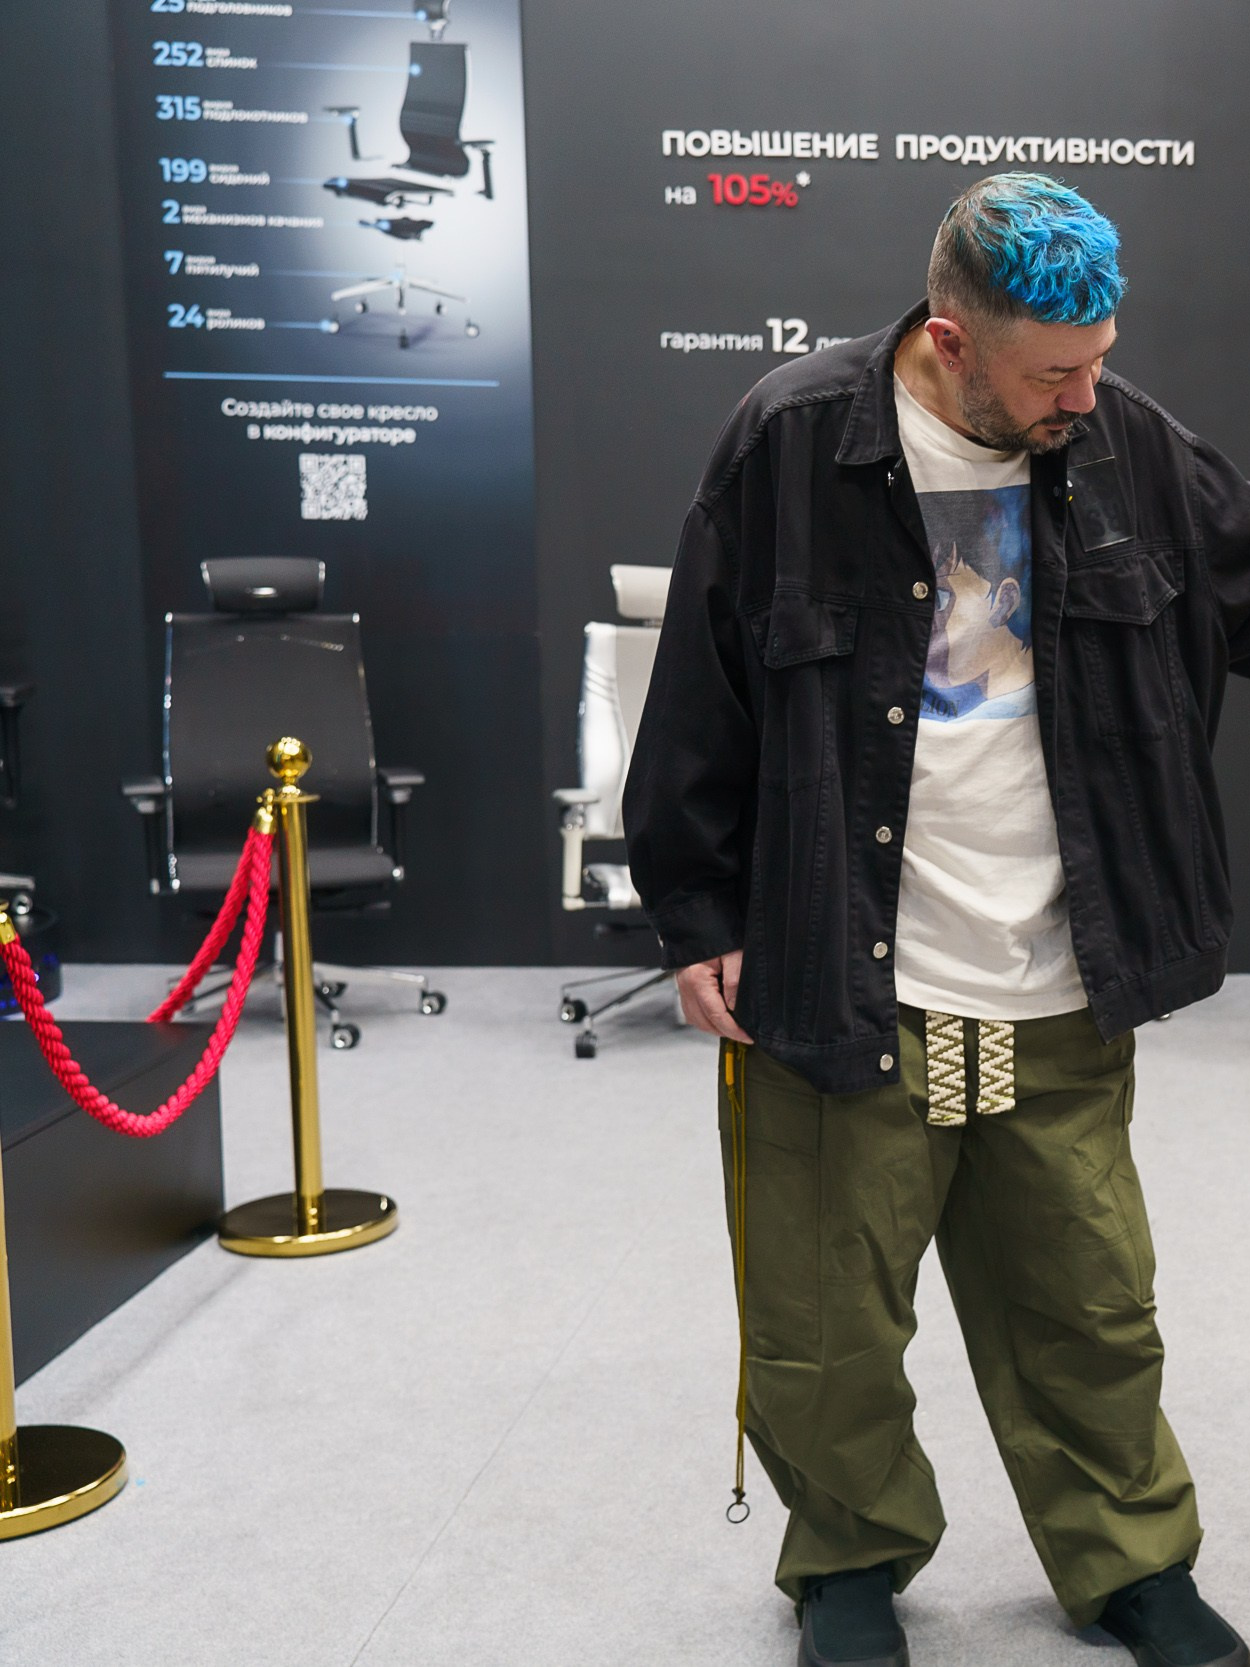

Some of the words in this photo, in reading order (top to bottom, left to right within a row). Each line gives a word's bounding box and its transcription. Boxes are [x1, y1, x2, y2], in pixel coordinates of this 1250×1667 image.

[153, 41, 204, 66] 252
[156, 95, 200, 120] 315
[662, 130, 879, 159] ПОВЫШЕНИЕ
[895, 133, 1195, 166] ПРОДУКТИВНОСТИ
[159, 157, 207, 183] 199
[664, 186, 697, 205] на
[162, 199, 181, 224] 2
[164, 250, 183, 275] 7
[167, 303, 205, 328] 24
[660, 331, 763, 353] гарантия
[766, 317, 810, 353] 12
[221, 398, 314, 419] Создайте
[317, 403, 364, 419] свое
[367, 405, 438, 423] кресло
[247, 424, 261, 440] в
[263, 421, 416, 446] конфигураторе
